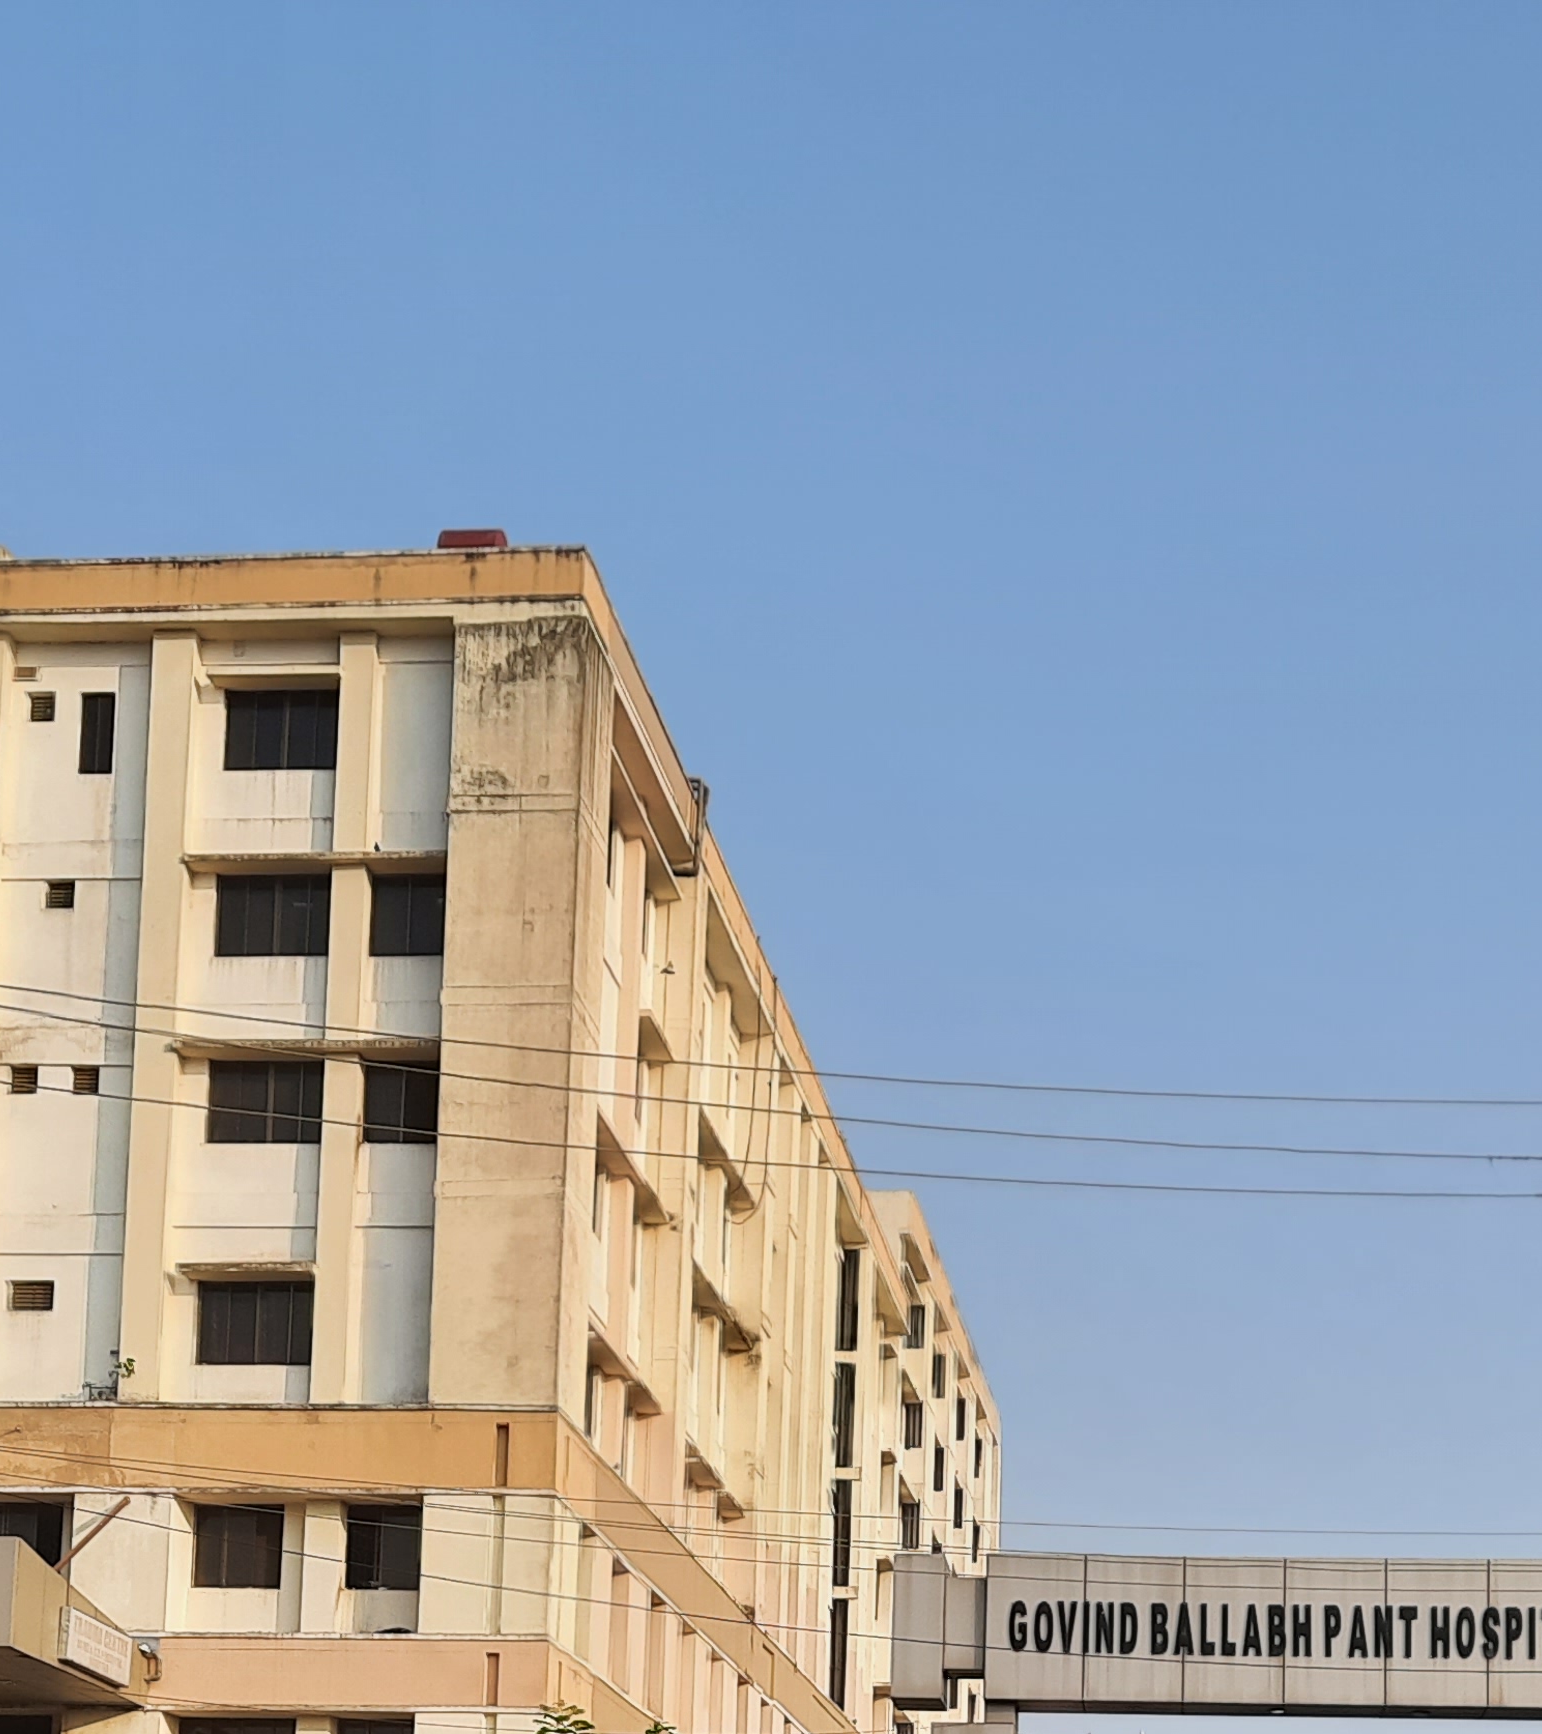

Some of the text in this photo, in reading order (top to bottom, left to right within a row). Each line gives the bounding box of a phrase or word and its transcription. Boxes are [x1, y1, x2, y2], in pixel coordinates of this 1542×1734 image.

[1008, 1600, 1138, 1655] GOVIND
[1150, 1602, 1312, 1658] BALLABH
[1324, 1605, 1418, 1659] PANT
